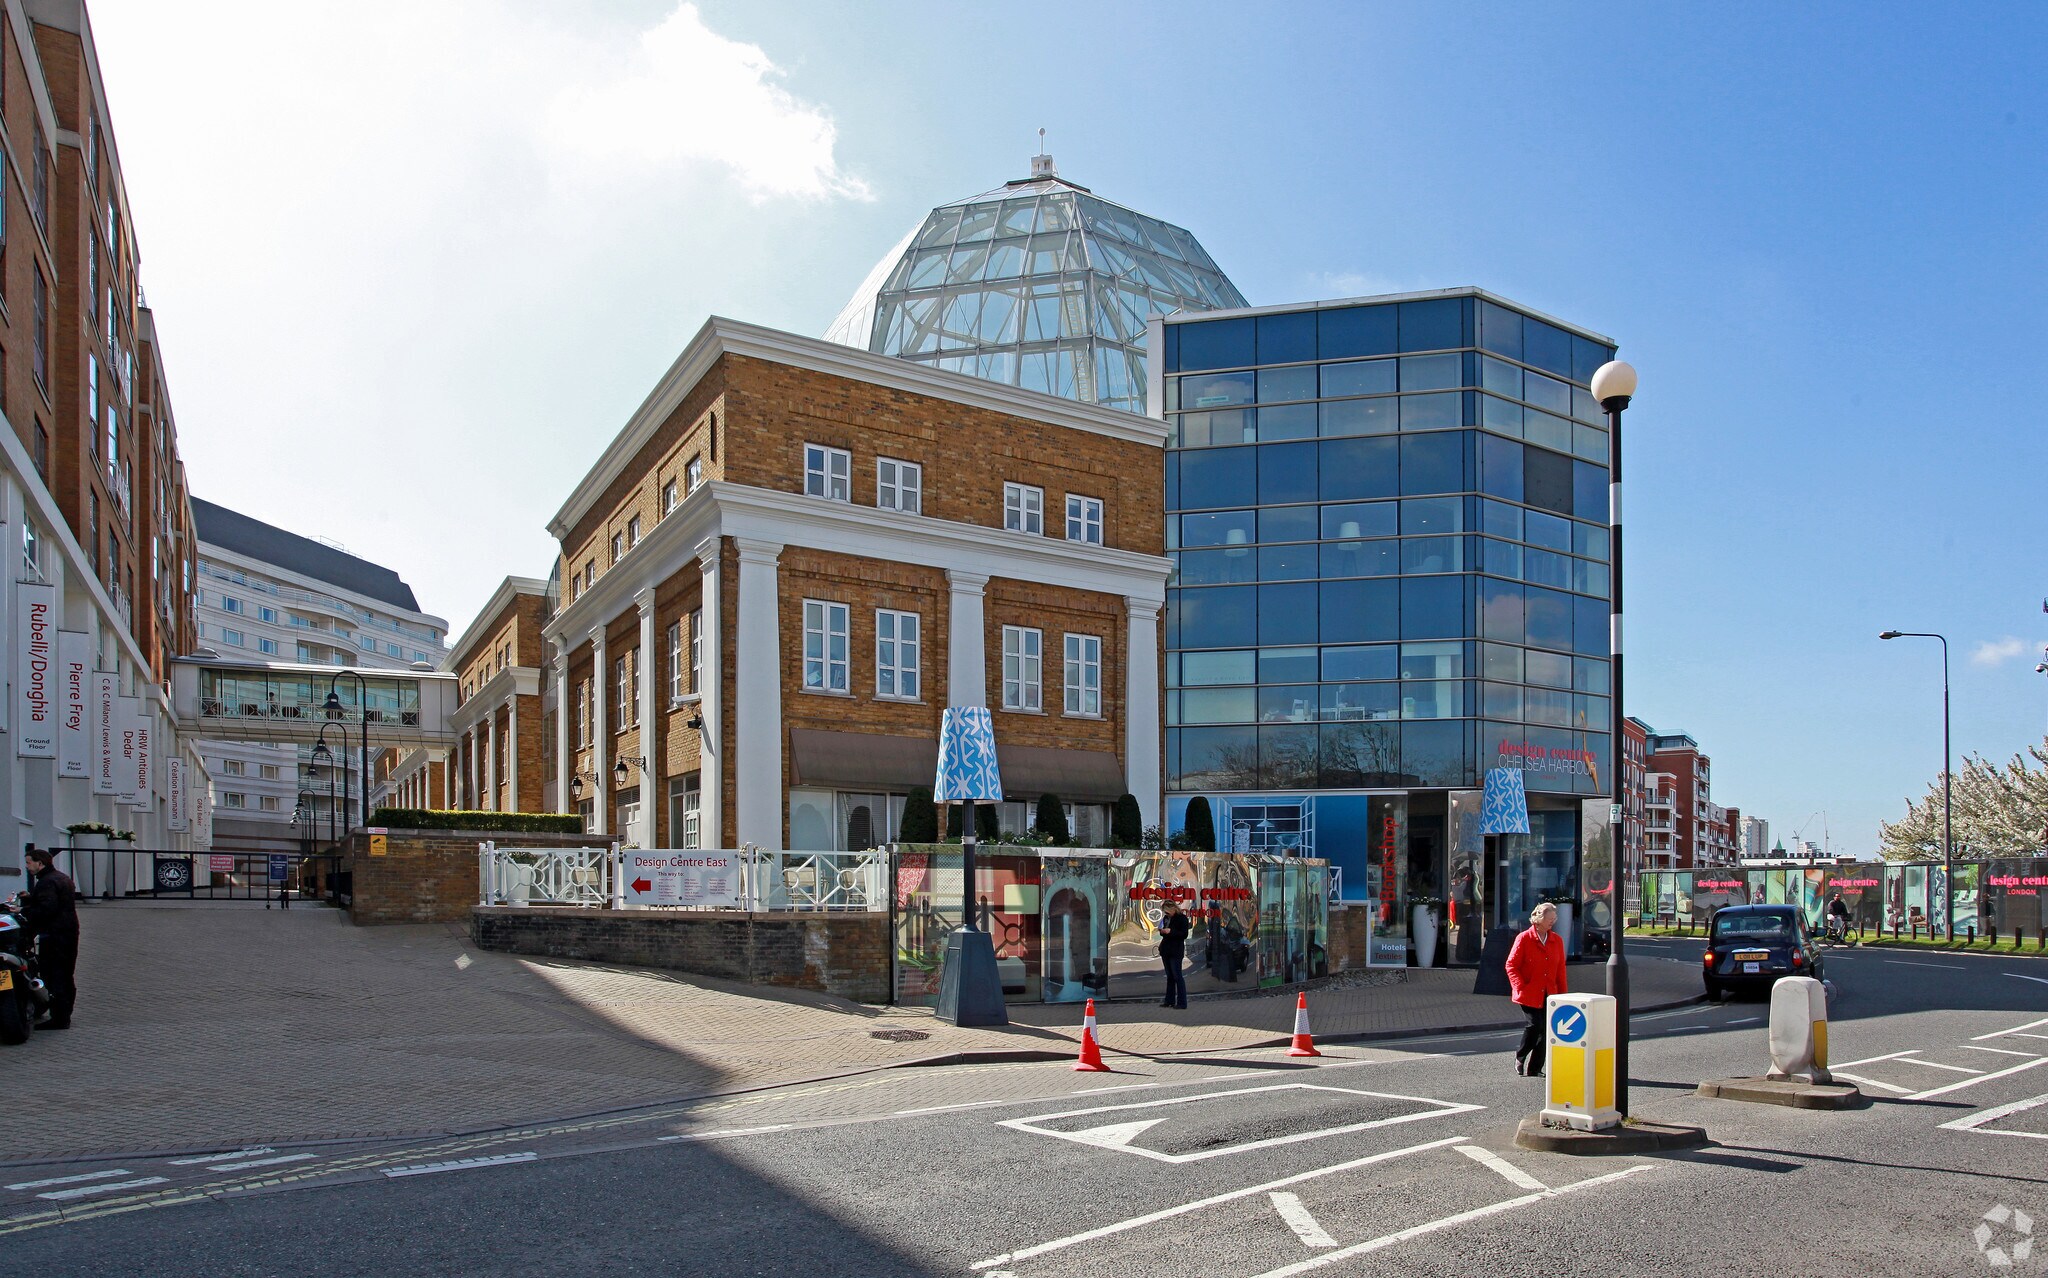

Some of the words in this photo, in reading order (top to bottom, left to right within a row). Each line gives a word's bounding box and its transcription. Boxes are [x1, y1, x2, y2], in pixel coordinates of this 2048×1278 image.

[26, 603, 49, 722] Rubelli/Donghia
[69, 662, 83, 700] Pierre
[66, 704, 83, 731] Frey
[124, 730, 134, 760] Dedar
[138, 729, 147, 749] HRW
[1498, 739, 1546, 758] design
[1550, 747, 1597, 762] centre
[102, 757, 111, 778] Wood
[138, 752, 148, 790] Antiques
[1498, 754, 1546, 772] CHELSEA
[1549, 759, 1596, 775] HARBOUR
[635, 857, 667, 869] Design
[670, 857, 704, 867] Centre
[707, 858, 727, 867] East
[1378, 817, 1401, 900] Bookshop
[1129, 882, 1196, 904] design
[1200, 886, 1251, 900] centre
[1697, 880, 1719, 888] design
[1829, 878, 1852, 888] design
